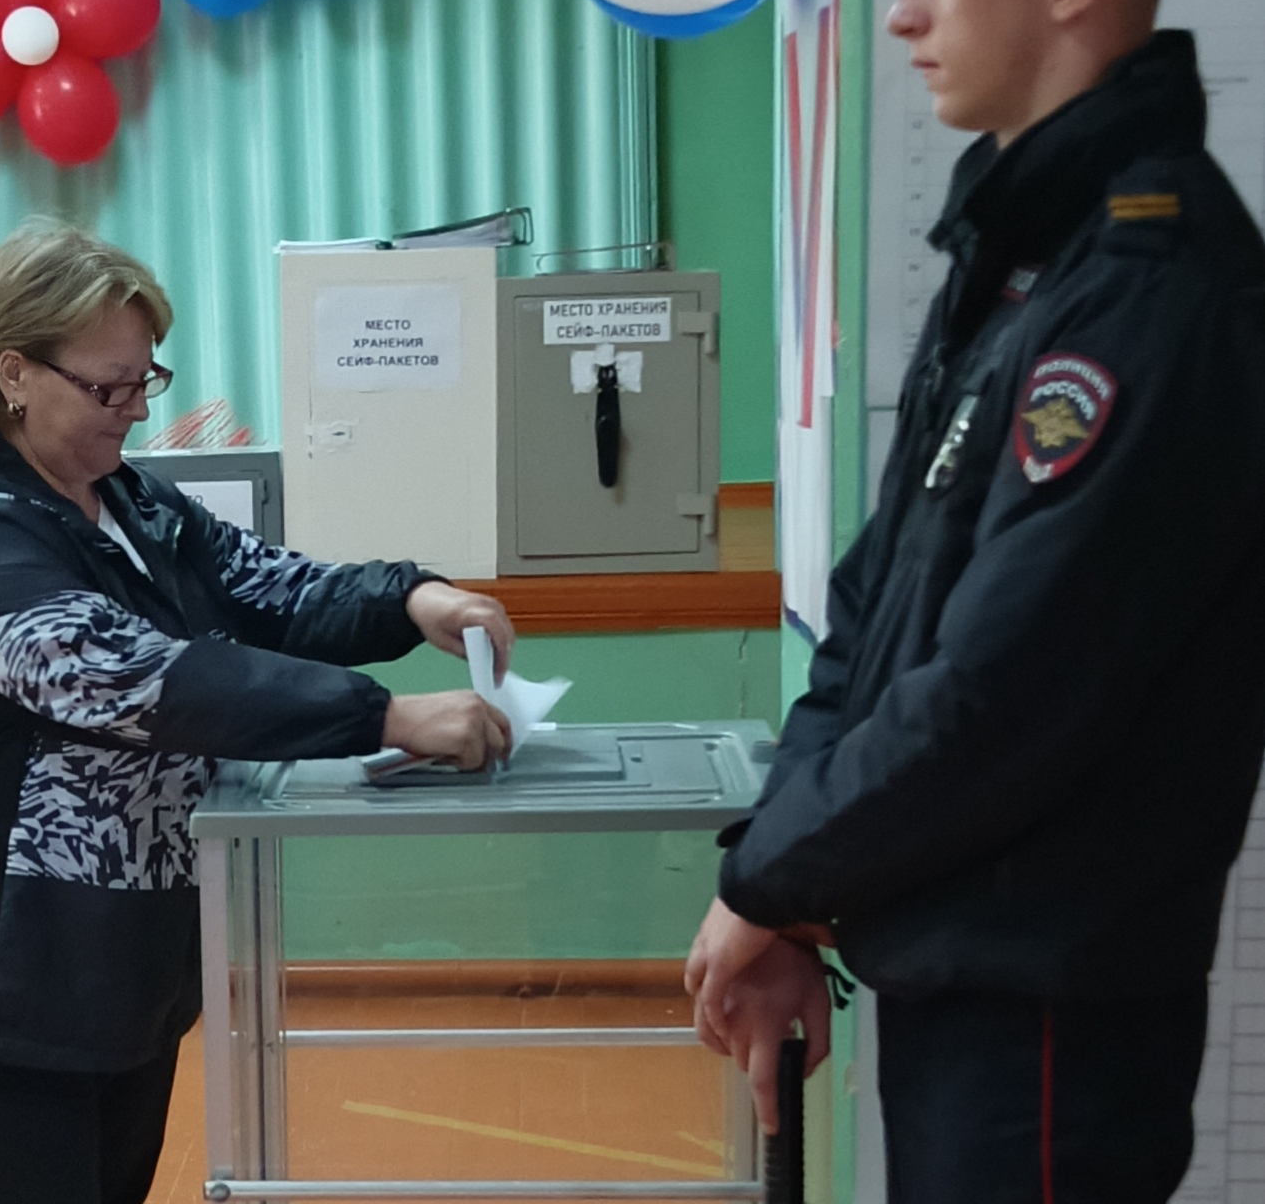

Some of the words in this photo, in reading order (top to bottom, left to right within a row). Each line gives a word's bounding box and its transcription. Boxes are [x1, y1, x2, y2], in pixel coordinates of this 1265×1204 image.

[550, 303, 593, 316] МЕСТО
[597, 301, 667, 315] ХРАНЕНИЯ
[365, 319, 411, 331] МЕСТО
[556, 322, 661, 338] СЕЙФ-ПАКЕТОВ
[353, 337, 424, 349] ХРАНЕНИЯ
[1033, 358, 1111, 401] ПОЛИЦИЯ
